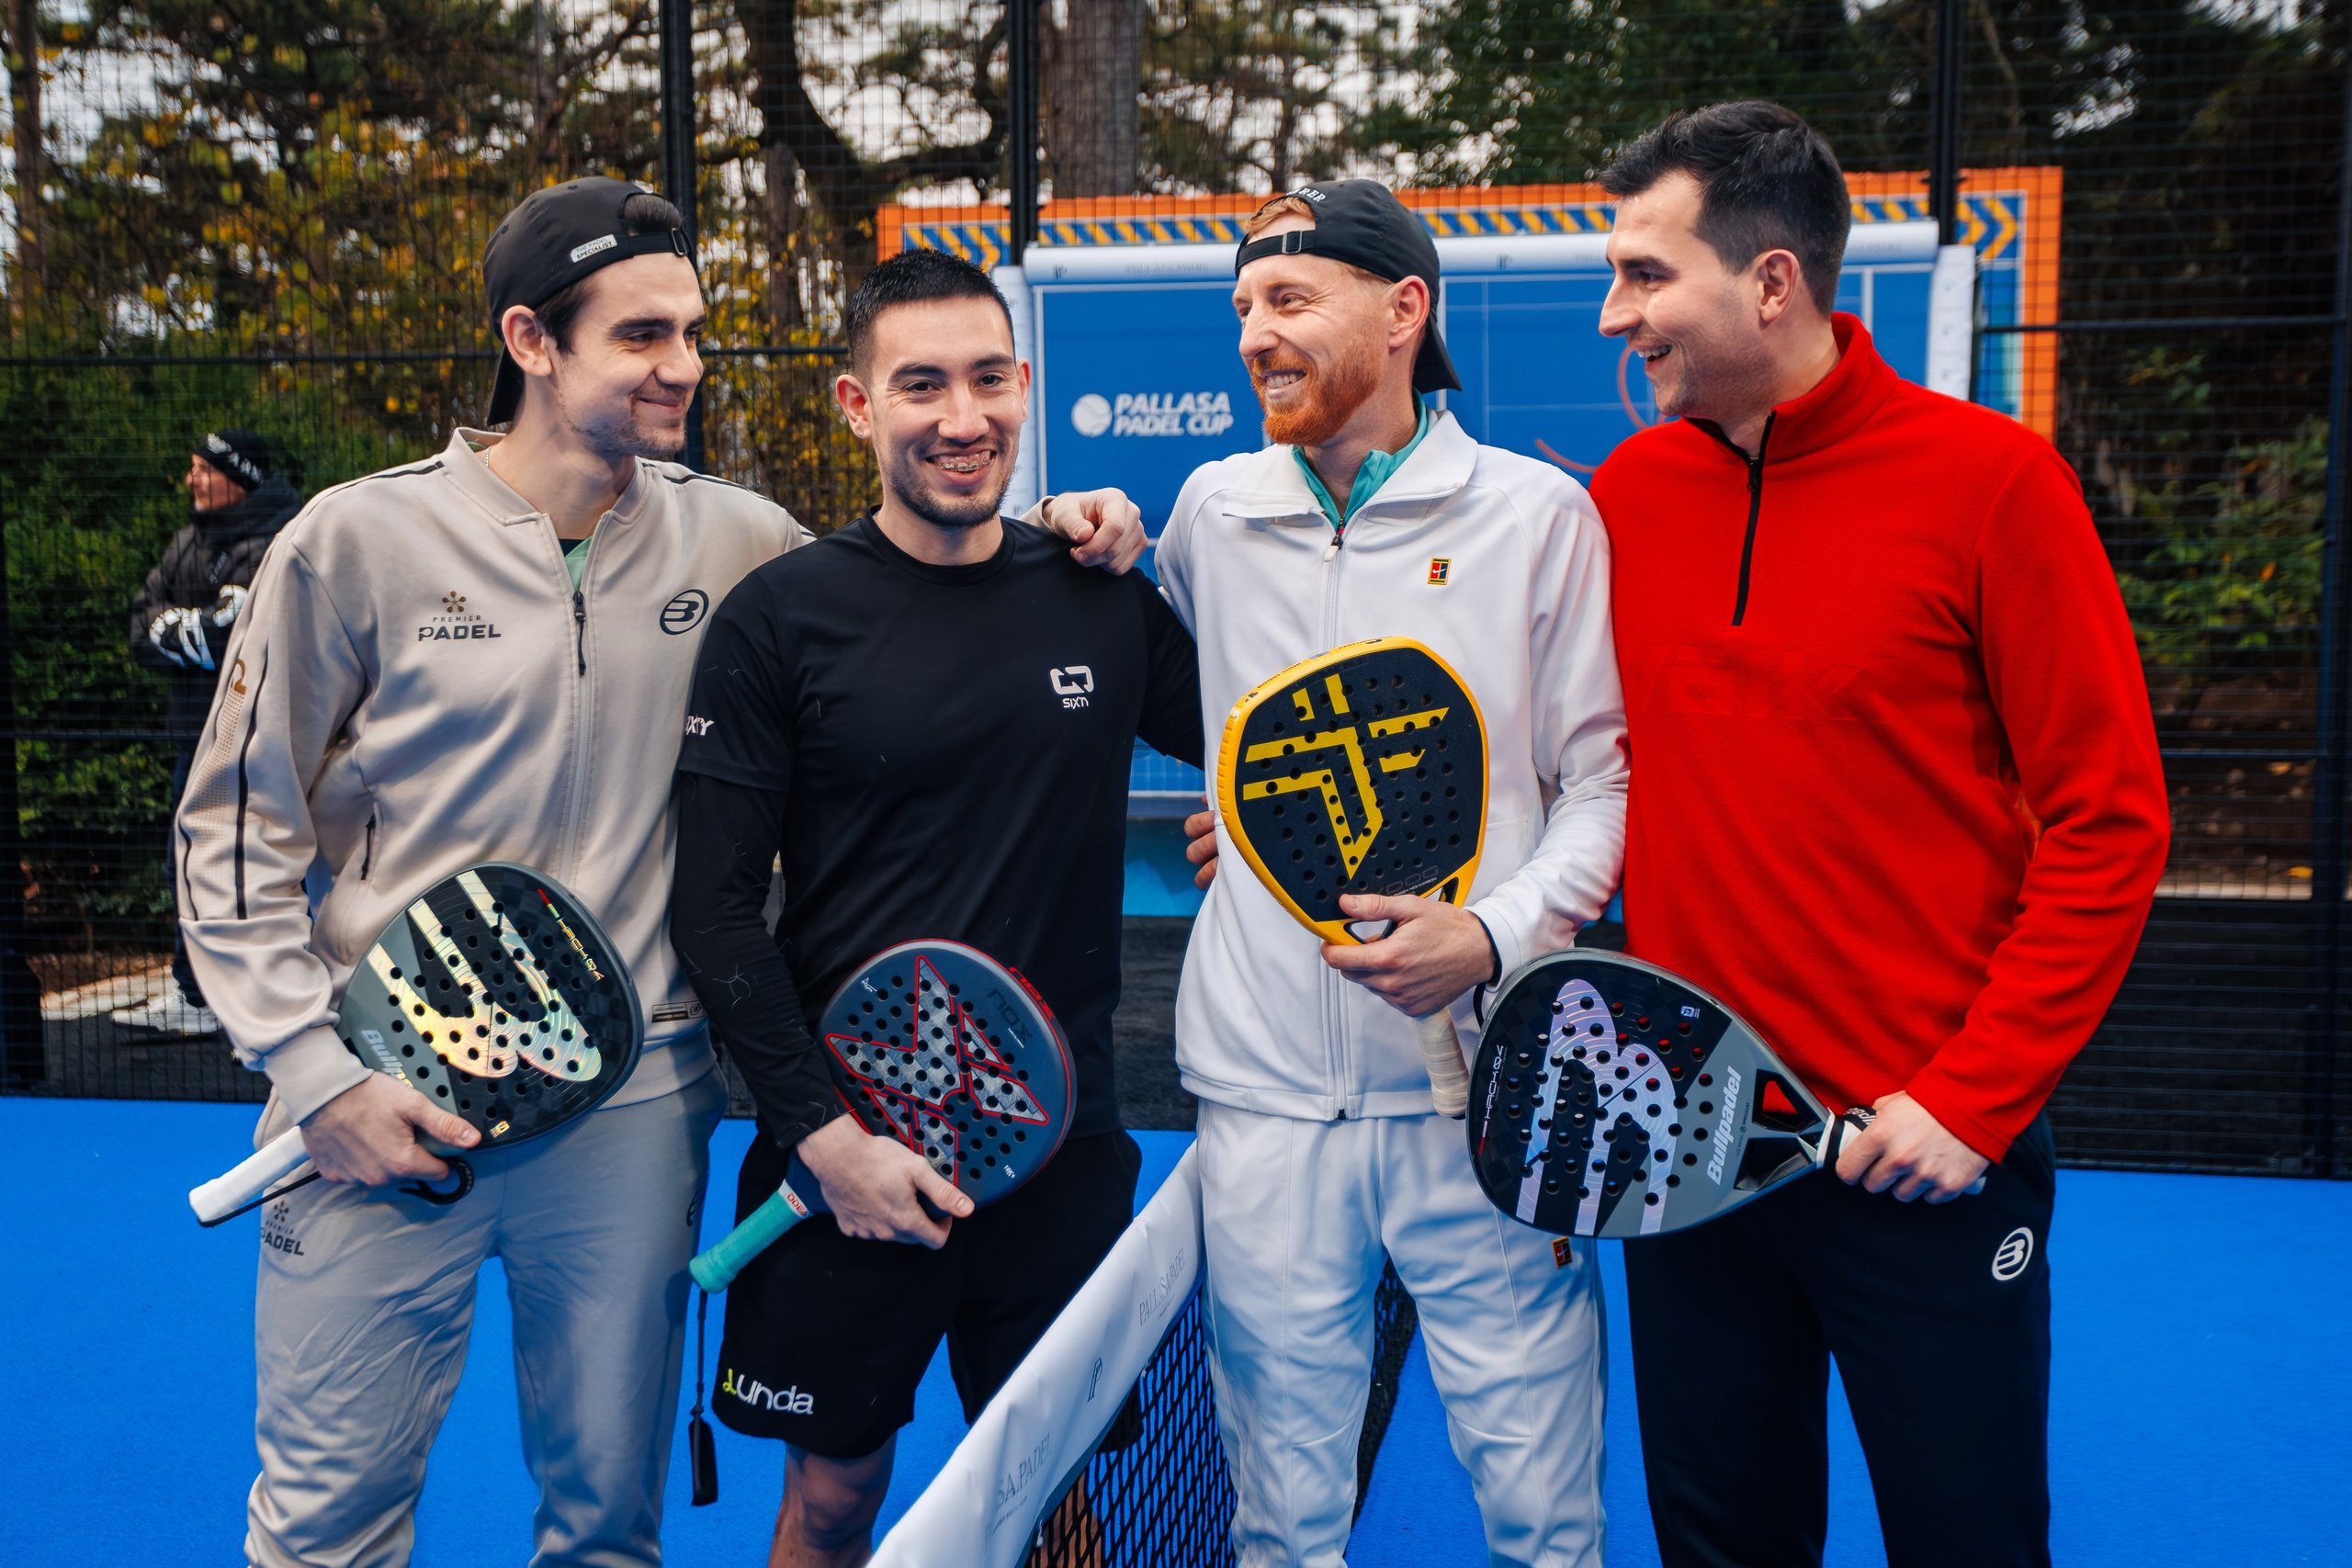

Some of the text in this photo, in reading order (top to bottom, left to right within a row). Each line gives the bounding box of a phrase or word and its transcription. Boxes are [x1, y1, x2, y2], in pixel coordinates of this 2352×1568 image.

[576, 241, 613, 259] SPECIALIST
[1114, 391, 1232, 414] PALLASA
[1112, 413, 1235, 437] PADEL CUP
[433, 615, 481, 623] PREMIER
[418, 624, 502, 642] PADEL
[1707, 1065, 1742, 1186] Bullpadel
